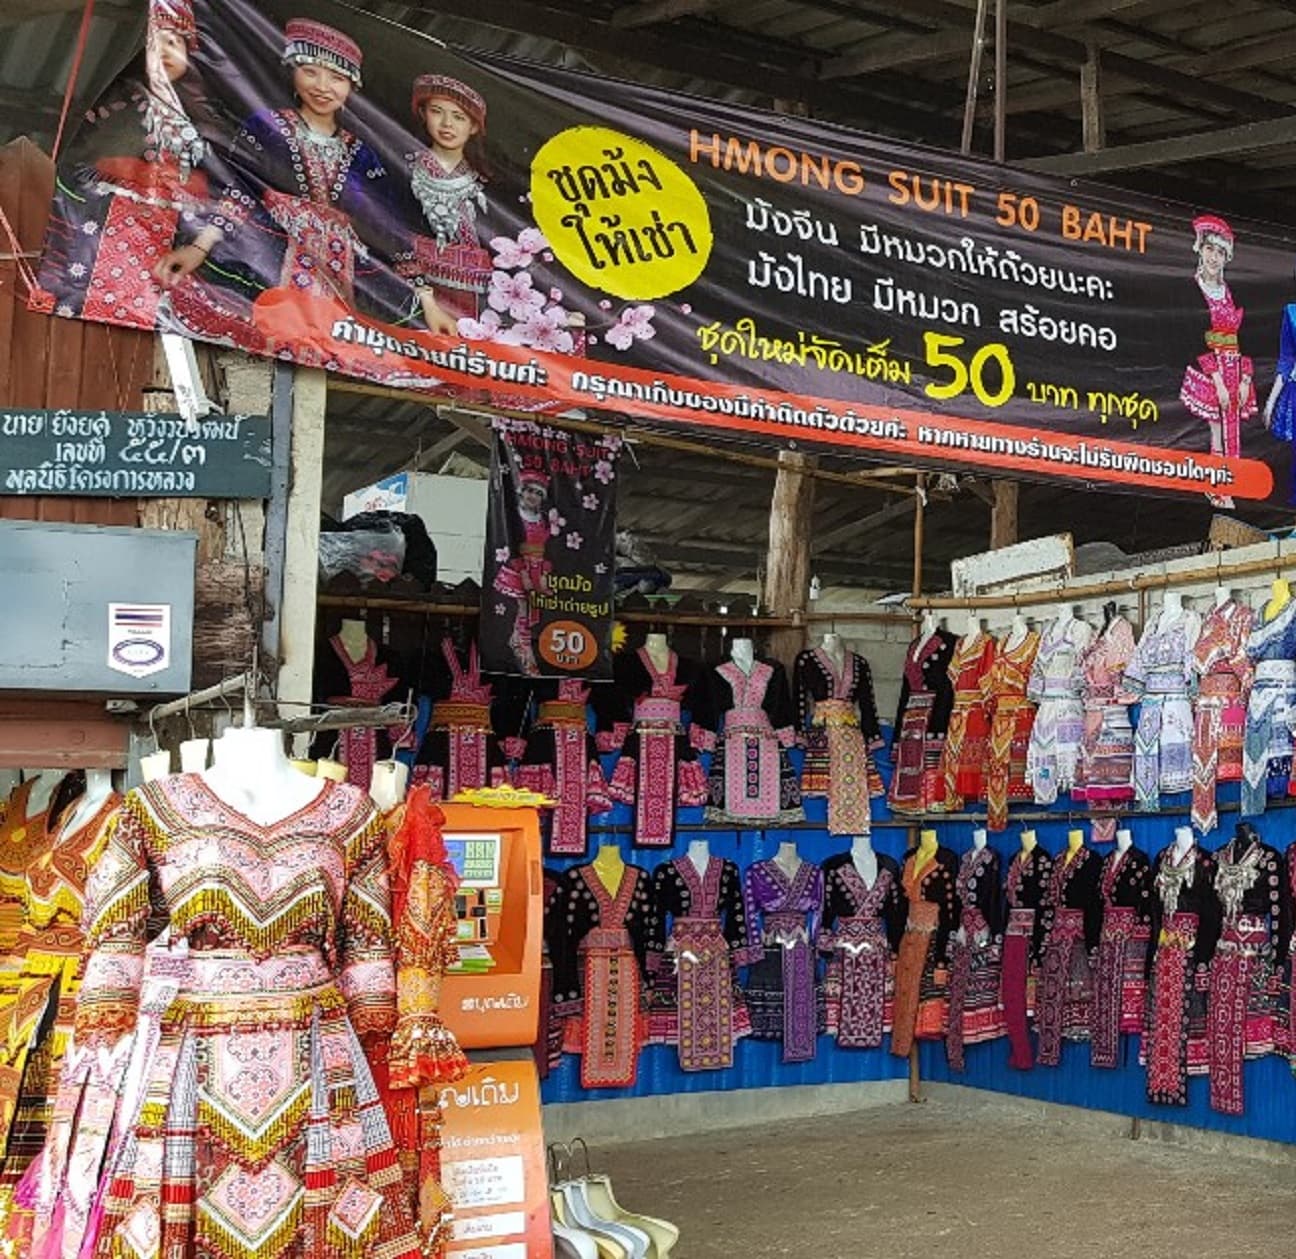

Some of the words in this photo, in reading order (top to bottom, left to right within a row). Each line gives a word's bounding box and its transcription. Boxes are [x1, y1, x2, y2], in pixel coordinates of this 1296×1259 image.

[547, 147, 663, 217] ชุดม้ง
[689, 128, 865, 196] HMONG
[887, 170, 976, 218] SUIT
[995, 192, 1041, 232] 50
[1061, 204, 1153, 254] BAHT
[561, 210, 698, 270] ให้เช่า
[745, 197, 839, 246] ม้งจีน
[860, 223, 1114, 300] มีหมวกให้ด้วยนะคะ
[748, 251, 852, 304] ม้งไทย
[873, 277, 981, 327] มีหมวก
[999, 303, 1118, 351] สร้อยคอ
[331, 316, 549, 385] ค่าชุดจ่ายที่ร้านค่ะ
[696, 317, 913, 385] ชุดใหม่จัดเต็ม
[922, 331, 1016, 407] 50
[1026, 381, 1078, 410] บาท
[1086, 391, 1160, 430] ทุกชุด
[2, 413, 43, 436] นาย
[505, 431, 568, 454] HMONG
[576, 443, 609, 460] SUIT
[524, 455, 542, 468] 50
[550, 458, 590, 477] BAHT
[550, 629, 584, 653] 50
